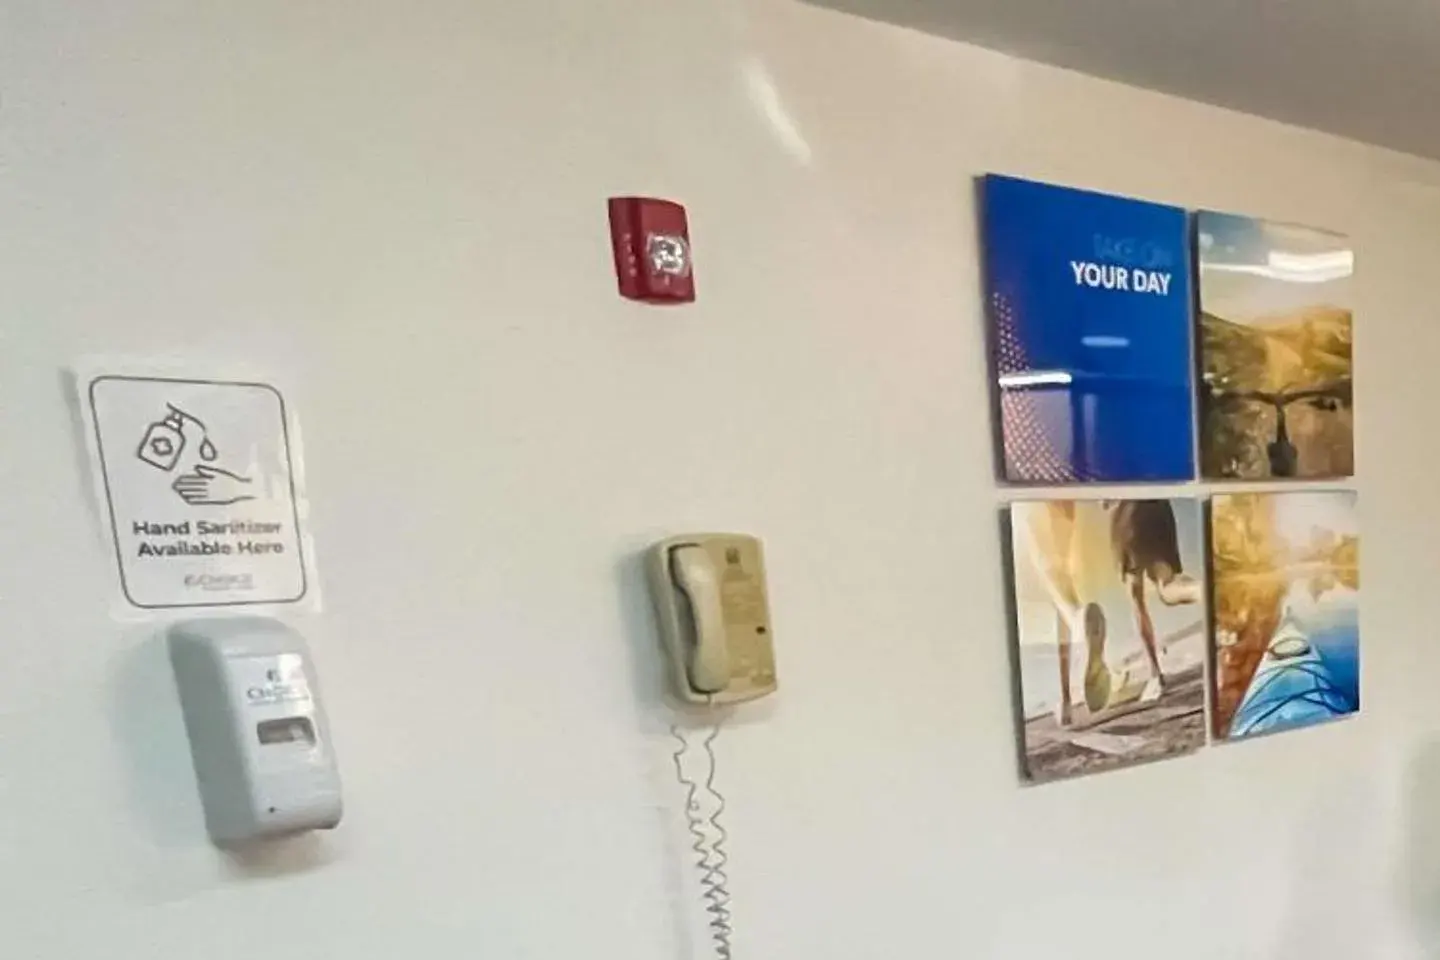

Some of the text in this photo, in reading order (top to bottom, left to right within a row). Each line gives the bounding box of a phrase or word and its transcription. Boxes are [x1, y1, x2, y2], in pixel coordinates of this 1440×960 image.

[1070, 260, 1172, 296] YOUR DAY
[132, 519, 282, 536] Hand Sanitizer
[137, 540, 285, 557] Available Here
